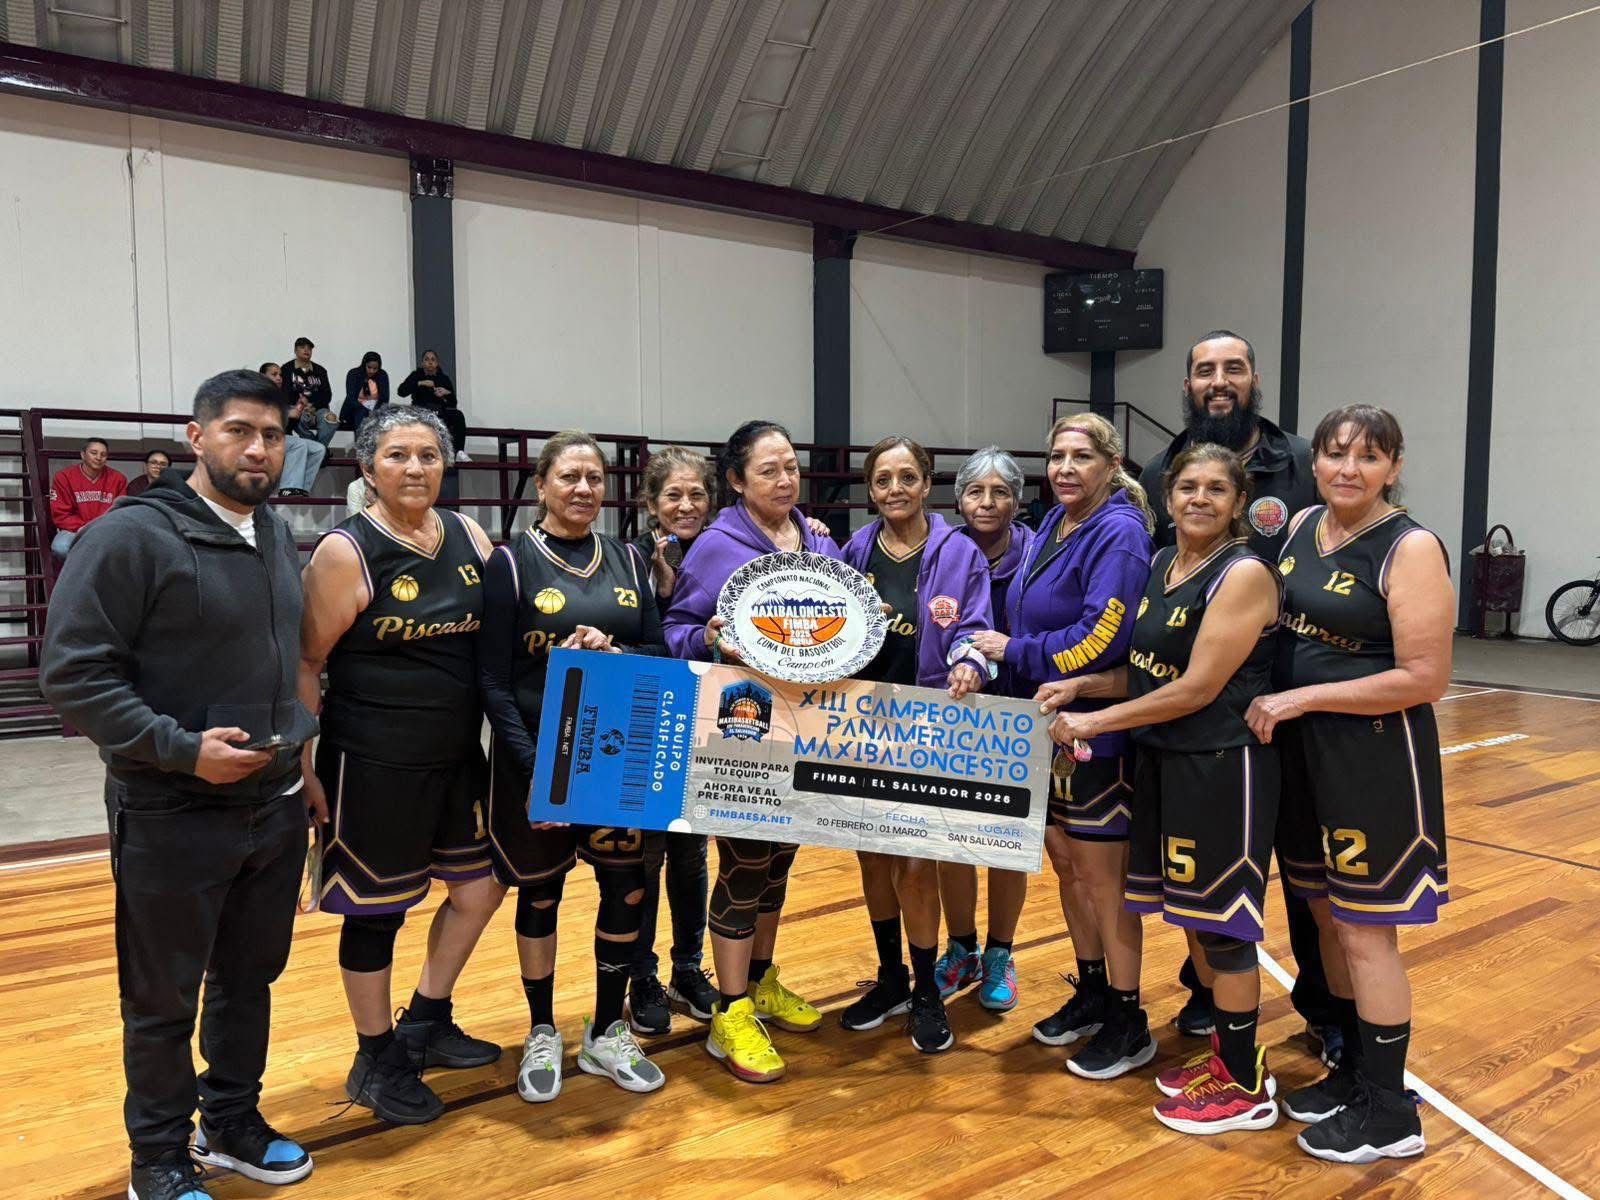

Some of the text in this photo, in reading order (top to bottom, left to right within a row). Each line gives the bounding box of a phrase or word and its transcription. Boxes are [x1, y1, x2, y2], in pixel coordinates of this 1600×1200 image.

[457, 564, 480, 586] 13
[756, 574, 832, 592] CAMPEONATO NACIONAL
[1322, 570, 1356, 596] 12
[613, 587, 638, 608] 23
[783, 618, 818, 630] FIMBA
[1166, 605, 1190, 628] 15
[1052, 597, 1126, 674] CHIHUAHUA
[756, 637, 779, 653] CUNA
[780, 646, 796, 657] DEL
[799, 636, 847, 657] BASQUETBOL
[799, 688, 848, 713] XIII
[856, 695, 1034, 735] CAMPEONATO
[576, 704, 599, 775] FIMBA
[652, 690, 674, 792] CLASIFICADO
[670, 713, 687, 771] EQUIPO
[826, 715, 1031, 759] PANAMERICANO
[695, 756, 790, 773] INVITACION PARA
[793, 734, 1029, 782] MAXIBALONCESTO
[714, 767, 770, 780] TU EQUIPO
[703, 782, 778, 797] AHORA VE AL
[813, 772, 1011, 804] FIMBA EL SALVADOR 2026
[697, 791, 782, 807] PRE-REGISTRO
[709, 808, 793, 825] FIMBAESA.NET
[885, 812, 929, 826] FECHA:
[816, 817, 928, 838] 20 FEBRERO 01 MARZO
[977, 824, 1023, 839] LUGAR:
[947, 832, 1022, 851] SAN SALVADOR
[1161, 833, 1196, 883] 5
